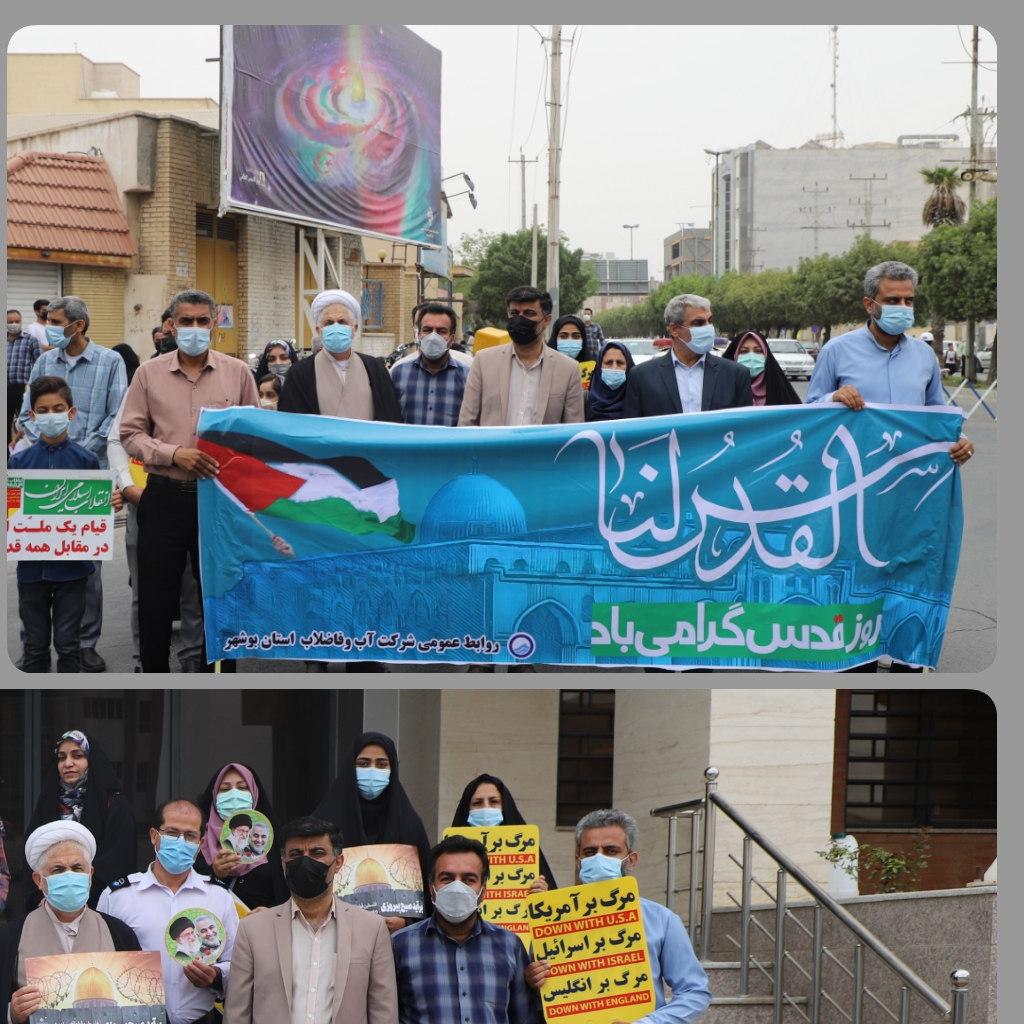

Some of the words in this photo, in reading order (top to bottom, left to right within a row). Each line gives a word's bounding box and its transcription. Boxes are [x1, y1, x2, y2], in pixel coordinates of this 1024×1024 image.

[56, 520, 77, 535] یک
[81, 519, 107, 536] قیام
[25, 543, 51, 553] همه
[54, 540, 89, 556] مقابل
[92, 543, 109, 556] در
[261, 632, 295, 649] استان
[354, 631, 374, 648] آب
[378, 631, 416, 650] شرکت
[746, 614, 844, 654] قدس
[844, 609, 881, 654] روز
[224, 631, 258, 651] بوشهر
[418, 636, 460, 651] عمومی
[463, 634, 500, 653] روابط
[488, 838, 503, 853] بر
[506, 833, 535, 852] مرگ
[487, 856, 506, 864] ITH
[509, 855, 534, 863] U.S.A
[492, 872, 505, 885] بر
[508, 868, 535, 884] مرگ
[485, 890, 502, 898] ITH
[504, 890, 529, 898] ISRAE
[600, 888, 635, 910] مرگ
[491, 907, 502, 919] بر
[506, 904, 528, 918] رگ
[528, 892, 580, 922] آمریکا
[583, 897, 597, 916] بر
[535, 923, 573, 938] DOWN
[574, 917, 604, 928] WITH
[607, 911, 637, 924] U.S.A
[592, 936, 606, 954] بر
[609, 928, 641, 948] مرگ
[536, 934, 589, 961] اسرائیل
[550, 963, 576, 975] OWN
[577, 958, 605, 971] WITH
[607, 952, 644, 966] ISRAEL
[597, 978, 610, 993] بر
[614, 970, 648, 988] مرگ
[543, 977, 592, 1002] انگلیس
[549, 1002, 579, 1016] DOWN
[579, 997, 605, 1010] WITH
[606, 992, 650, 1007] ENGLAND
